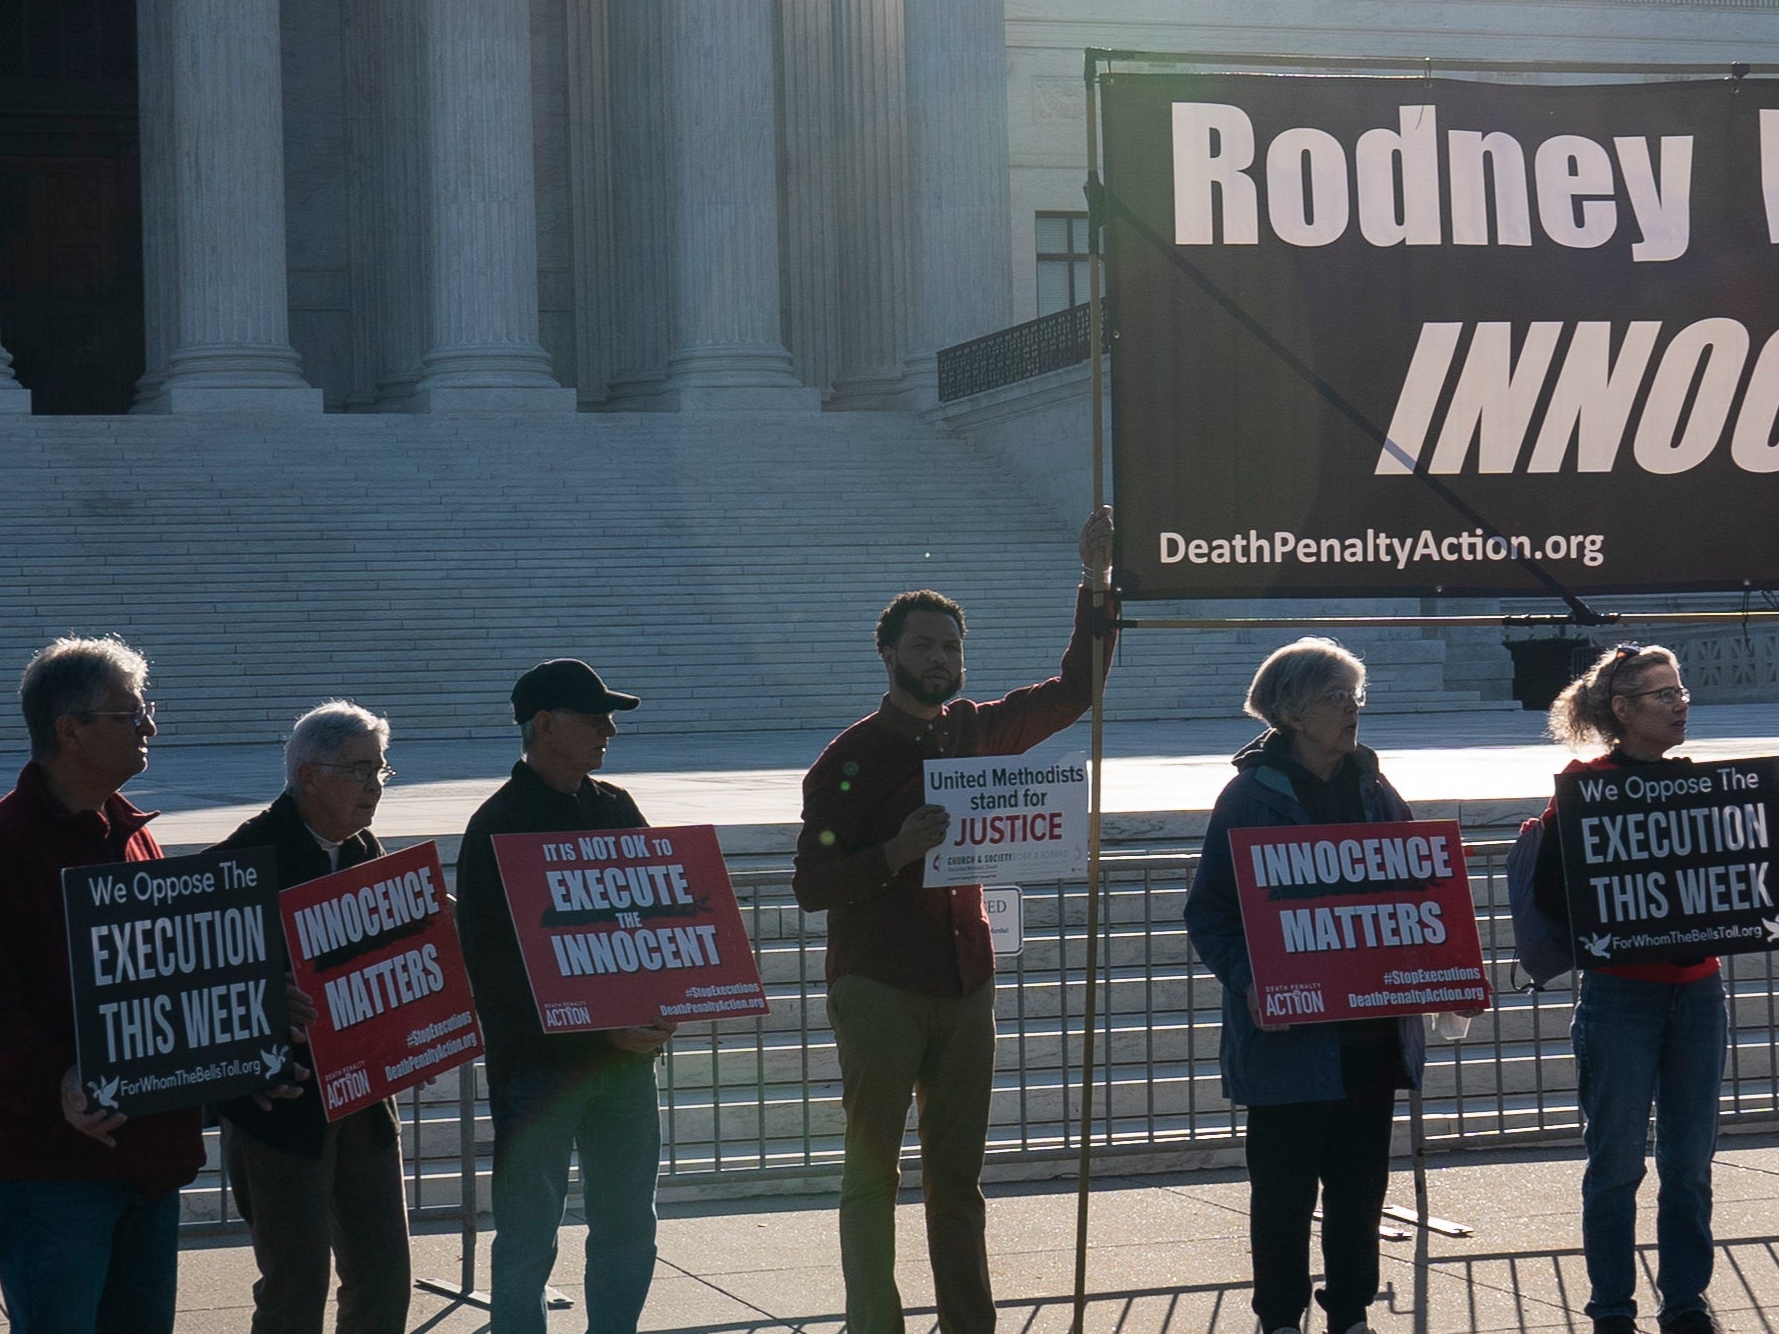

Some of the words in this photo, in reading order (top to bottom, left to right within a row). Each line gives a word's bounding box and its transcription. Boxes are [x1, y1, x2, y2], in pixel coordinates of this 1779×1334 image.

[1171, 100, 1693, 262] Rodney
[1158, 527, 1605, 571] DeathPenaltyAction.org
[930, 769, 987, 790] United
[992, 765, 1084, 787] Methodists
[1579, 778, 1619, 803] We
[1625, 775, 1712, 803] Oppose
[1717, 767, 1759, 791] The
[971, 789, 1018, 810] stand
[1023, 788, 1048, 807] for
[542, 843, 557, 861] IT
[559, 843, 576, 861] IS
[579, 836, 618, 861] NOT
[620, 834, 651, 859] OK
[652, 838, 673, 857] TO
[953, 812, 1062, 847] JUSTICE
[1581, 802, 1769, 864] EXECUTION
[977, 854, 983, 863] &
[984, 852, 1013, 863] SOCIETY
[1250, 836, 1453, 888] INNOCENCE
[88, 875, 127, 907] We
[133, 871, 215, 907] Oppose
[219, 860, 258, 890] The
[546, 864, 694, 912] EXECUTE
[1590, 871, 1669, 923] THIS
[1675, 862, 1774, 915] WEEK
[294, 866, 441, 961] INNOCENCE
[615, 912, 643, 929] THE
[1279, 901, 1447, 953] MATTERS
[91, 905, 267, 987] EXECUTION
[551, 924, 721, 977] INNOCENT
[1612, 926, 1762, 950] ForWhomTheBellsToll.org
[324, 943, 445, 1032] MATTERS
[685, 982, 760, 999] #StopExecutions
[1384, 967, 1481, 986] #StopExecutions
[660, 997, 765, 1017] DeathPenaltyAction.org
[1266, 989, 1325, 1016] ACTION
[1348, 987, 1484, 1008] DeathPenaltyAction.org
[99, 994, 175, 1063] THIS
[181, 978, 271, 1049] WEEK
[406, 1011, 472, 1048] #StopExecutions
[546, 1006, 591, 1028] ACTION
[385, 1032, 478, 1082] DeathPenaltyAction.org
[121, 1059, 261, 1096] ForWhomTheBellsToll.org
[327, 1068, 371, 1110] ACTION
